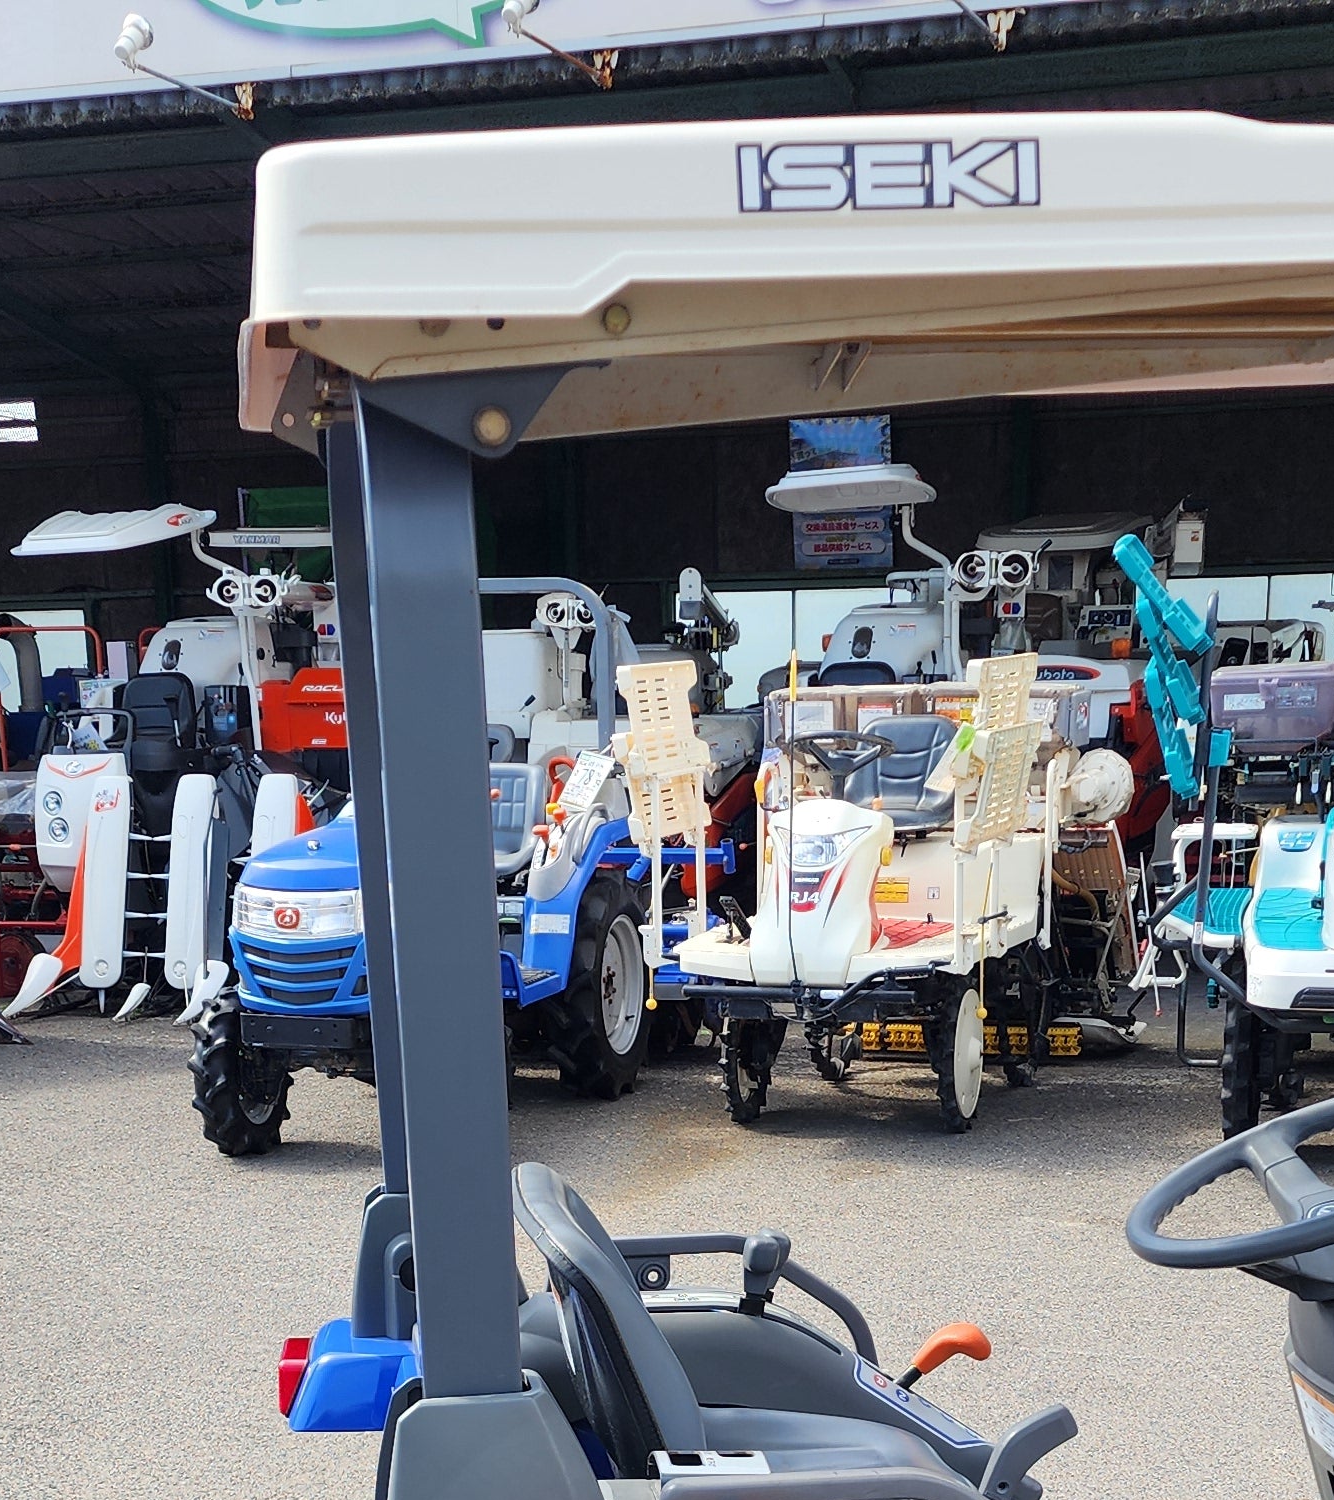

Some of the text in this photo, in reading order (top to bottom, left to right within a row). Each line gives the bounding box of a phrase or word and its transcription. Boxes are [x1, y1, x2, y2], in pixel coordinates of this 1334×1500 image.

[736, 138, 1040, 213] ISEKI
[233, 535, 281, 544] YANMAR
[1037, 669, 1075, 679] ubota
[790, 891, 820, 903] RJ4
